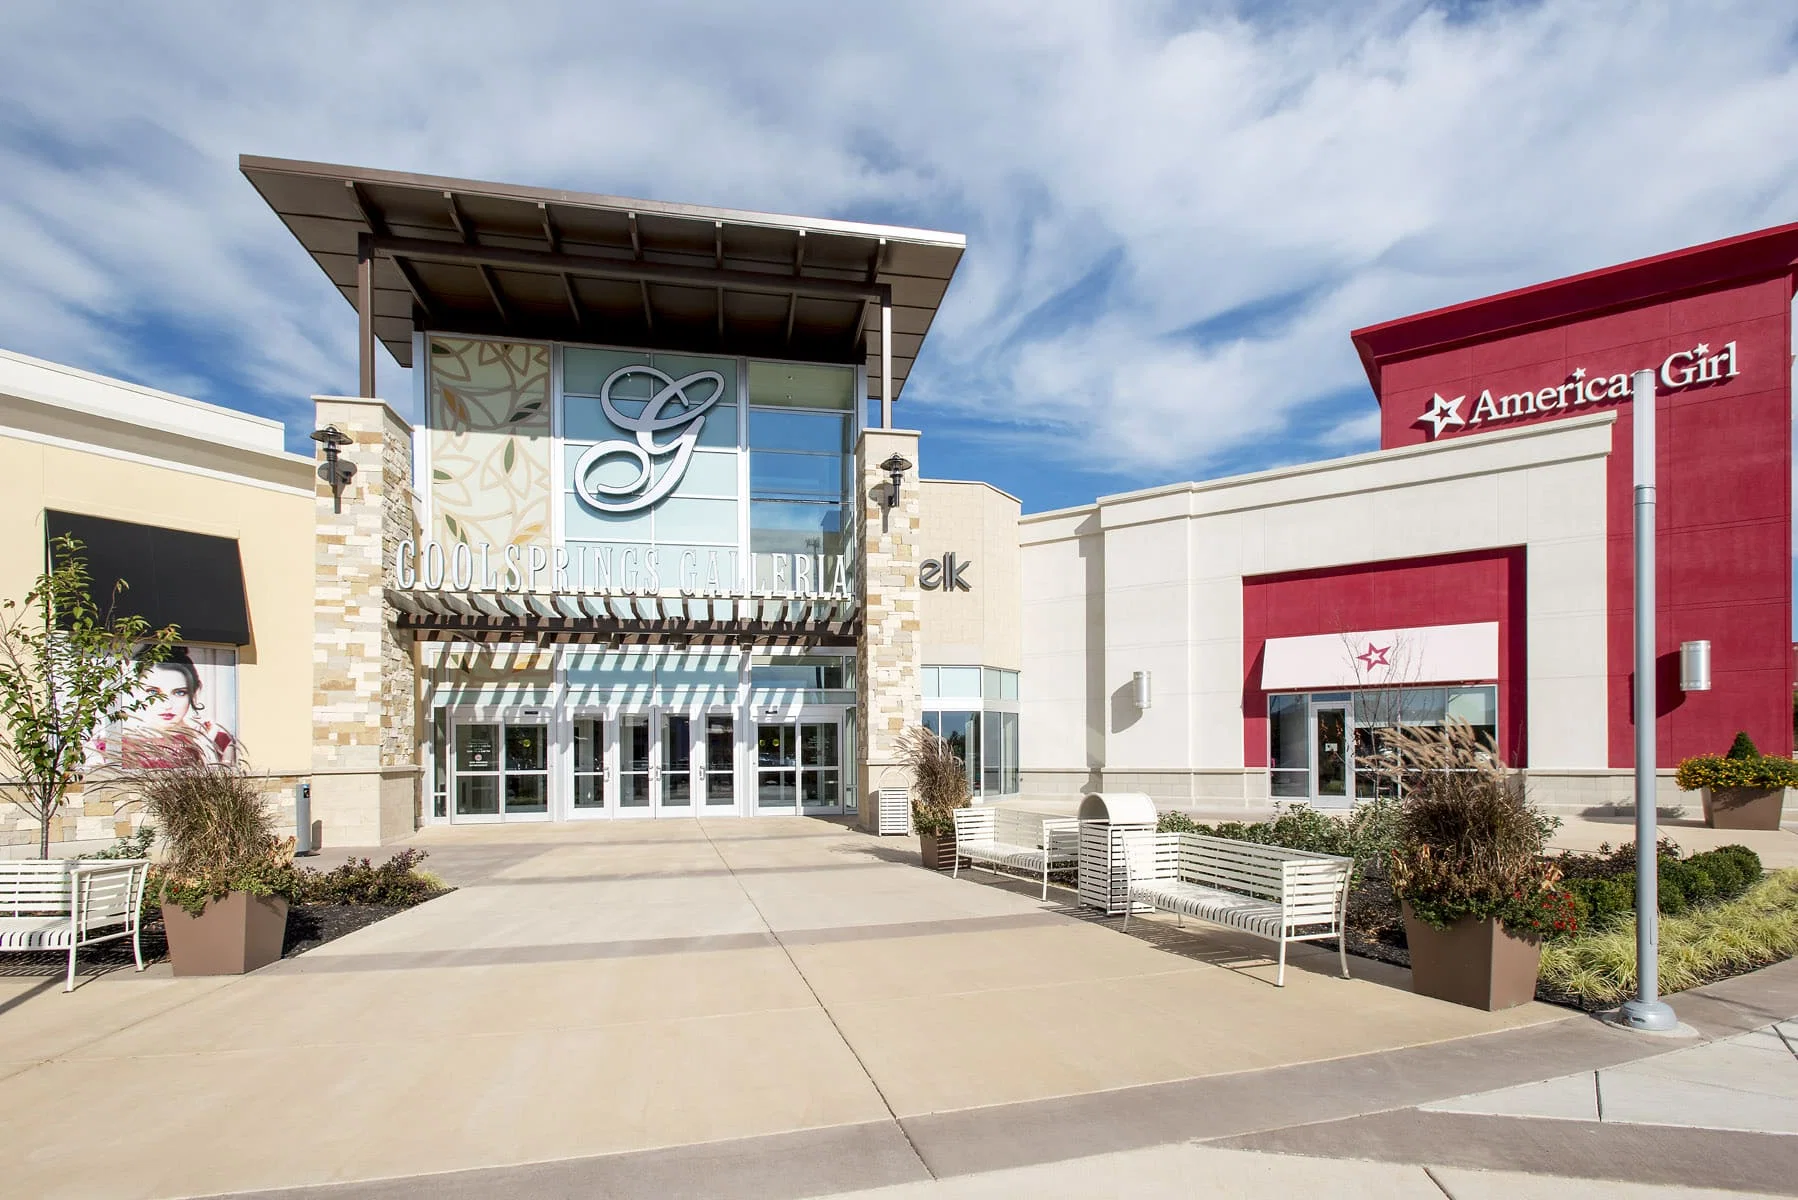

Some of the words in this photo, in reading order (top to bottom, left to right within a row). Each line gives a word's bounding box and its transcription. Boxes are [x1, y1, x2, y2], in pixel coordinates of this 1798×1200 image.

[1468, 367, 1657, 423] America
[1660, 340, 1741, 387] Girl
[396, 539, 660, 595] COOLSPRINGS
[679, 550, 849, 599] GALLERIA
[919, 551, 972, 592] elk
